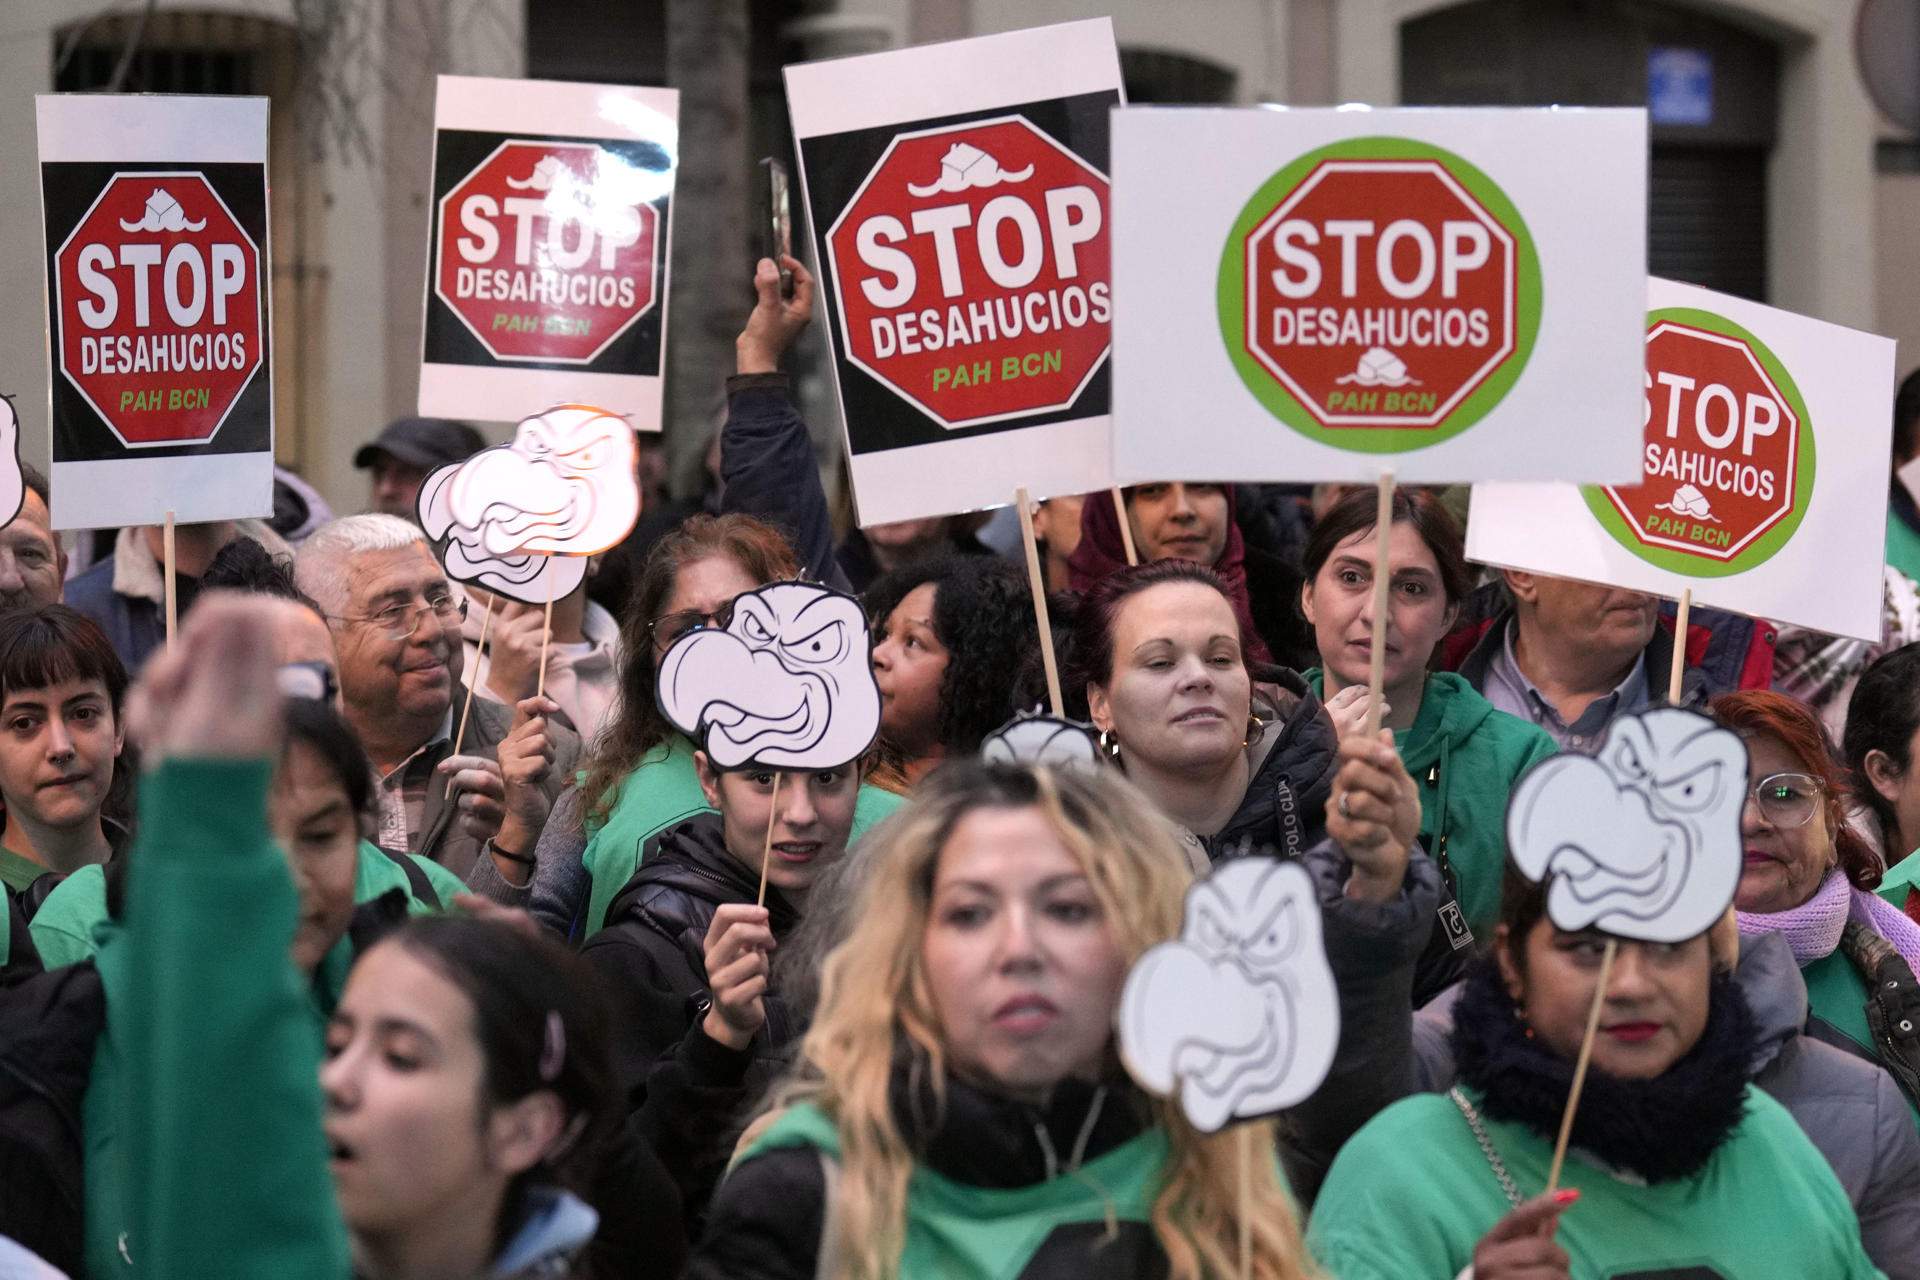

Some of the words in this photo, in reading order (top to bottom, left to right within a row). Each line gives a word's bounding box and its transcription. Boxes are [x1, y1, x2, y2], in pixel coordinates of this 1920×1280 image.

[457, 194, 643, 271] STOP
[856, 185, 1103, 309] STOP
[1271, 219, 1492, 299] STOP
[77, 242, 246, 330] STOP
[456, 267, 635, 308] DESAHUCIOS
[492, 313, 539, 334] PAH
[870, 282, 1112, 359] DESAHUCIOS
[1272, 307, 1490, 347] DESAHUCIOS
[81, 332, 246, 375] DESAHUCIOS
[933, 360, 991, 392] PAH
[1001, 349, 1061, 381] BCN
[119, 391, 163, 412] PAH
[168, 388, 210, 410] BCN
[1327, 391, 1378, 411] PAH
[1384, 391, 1437, 412] BCN
[1645, 371, 1779, 456] TOP
[1645, 443, 1774, 501] SAHUCIOS
[1645, 515, 1686, 537] PAH
[1690, 522, 1732, 547] BCN
[1283, 814, 1301, 857] POLO
